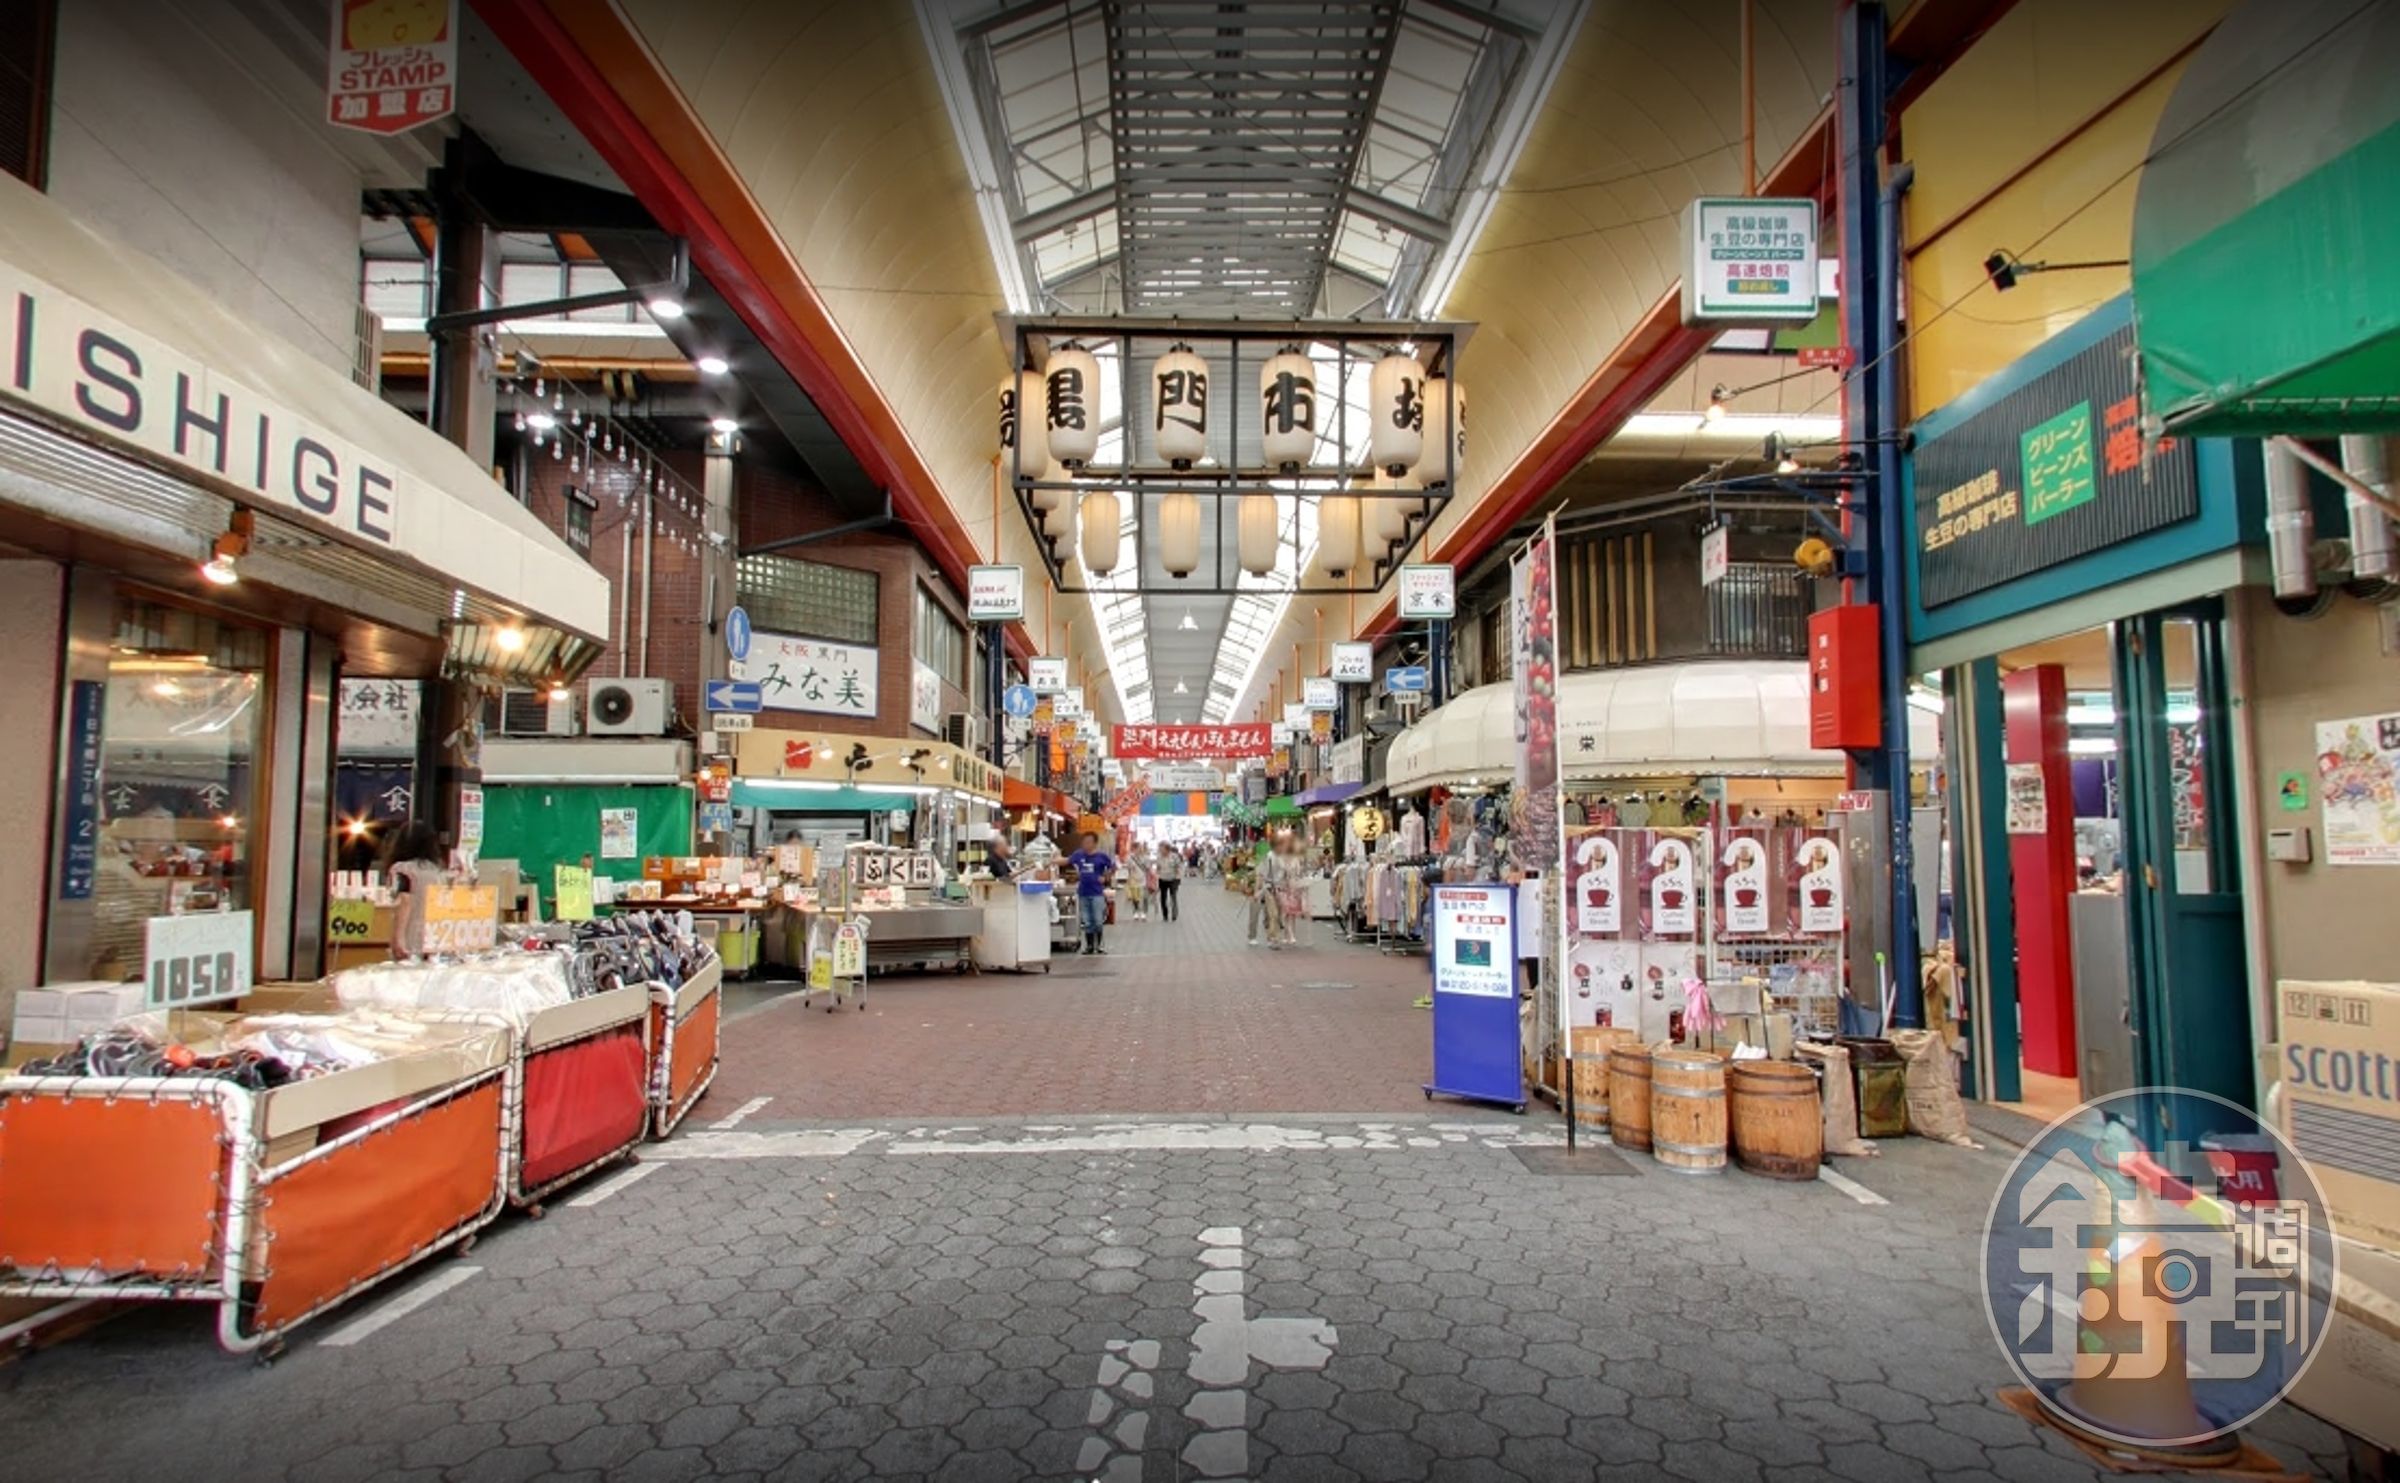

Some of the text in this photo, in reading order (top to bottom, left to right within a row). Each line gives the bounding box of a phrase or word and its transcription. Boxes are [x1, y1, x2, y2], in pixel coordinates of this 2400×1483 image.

[350, 47, 434, 69] フレッシュ
[340, 62, 447, 90] STAMP
[339, 88, 445, 120] 加盟店
[1711, 232, 1805, 247] 生豆の専門店
[14, 292, 395, 542] ISHIGE
[2028, 417, 2088, 461] グリーン
[2030, 445, 2089, 488] ビーンズ
[2031, 477, 2090, 512] パーラー
[1924, 491, 2017, 552] 生豆の専門店
[778, 641, 810, 658] 大阪
[760, 661, 866, 709] みな美
[78, 820, 94, 837] 2
[153, 951, 236, 1003] 1050
